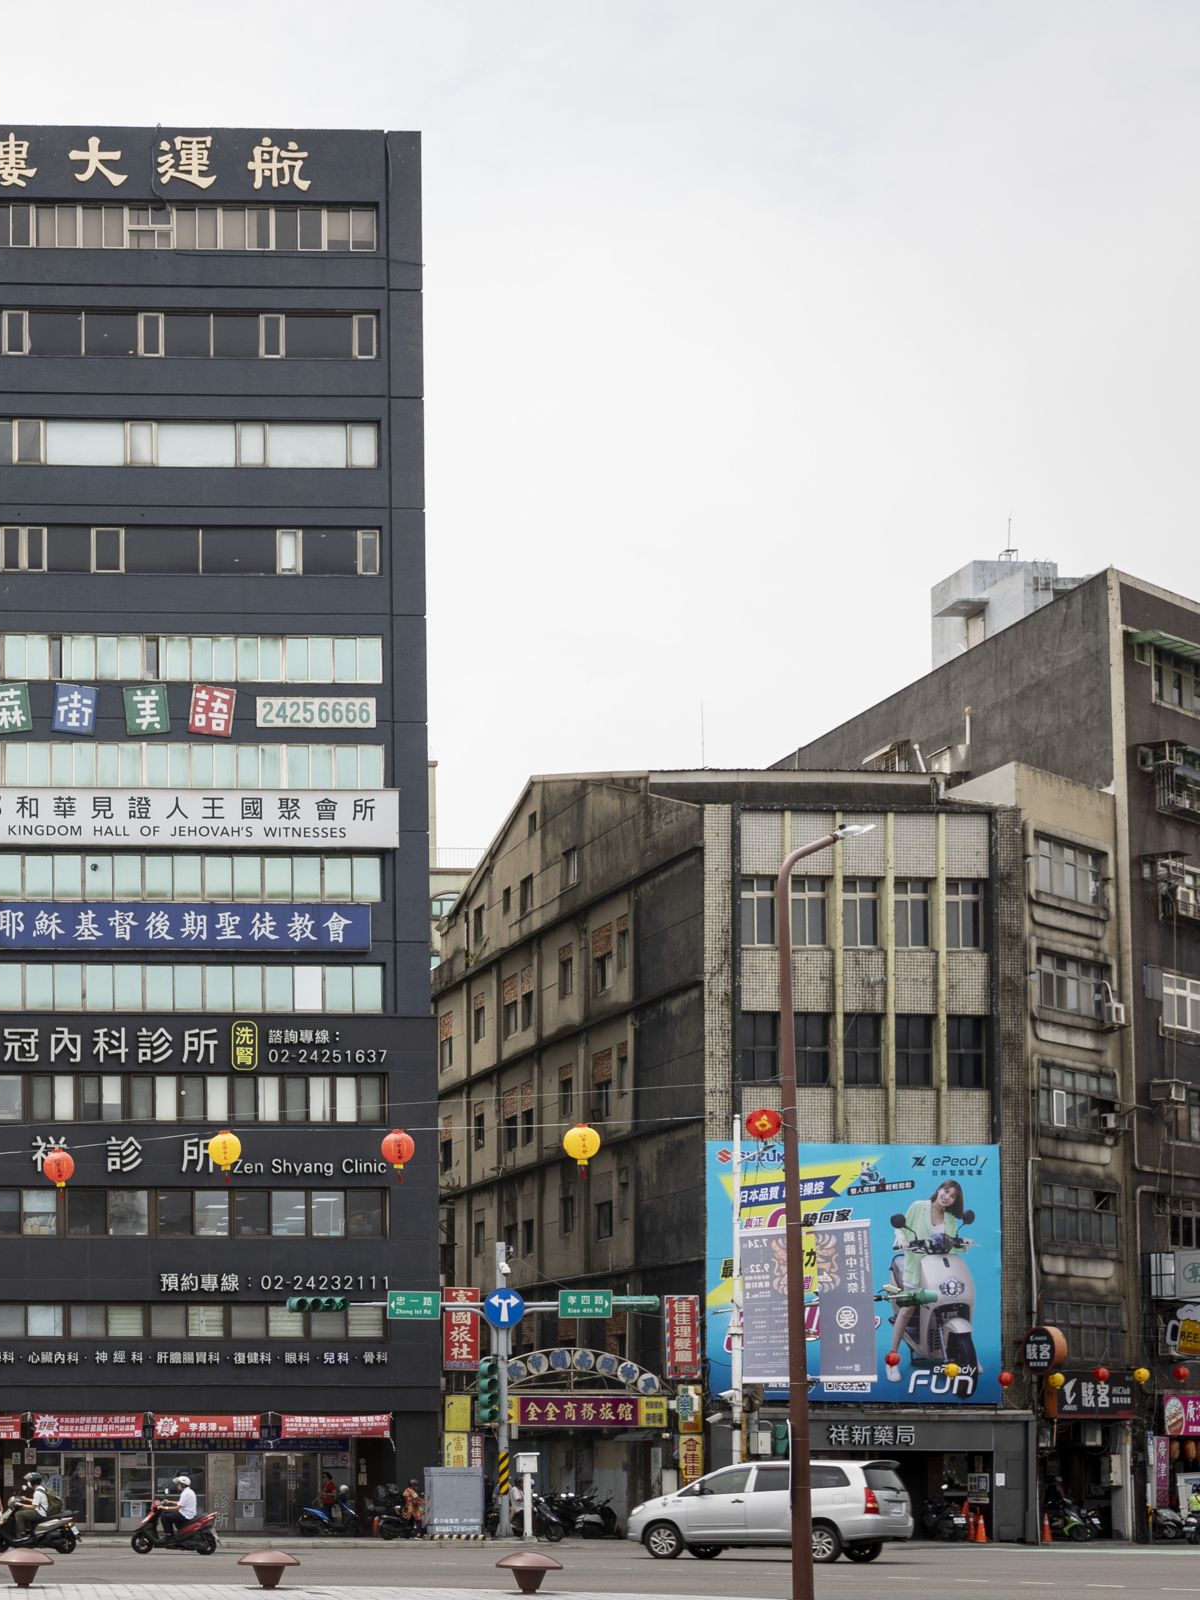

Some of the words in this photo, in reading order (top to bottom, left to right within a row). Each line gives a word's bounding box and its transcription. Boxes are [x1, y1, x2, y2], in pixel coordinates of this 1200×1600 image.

[262, 700, 371, 725] 24256666
[7, 824, 82, 838] KINGDOM
[93, 824, 130, 837] HALL
[140, 824, 161, 838] OF
[170, 824, 254, 838] JEHOVAH'S
[263, 825, 347, 839] WITNESSES
[235, 1026, 254, 1066] 洗腎
[268, 1048, 388, 1064] 02-24251637
[740, 1151, 785, 1162] SUZUK
[233, 1158, 264, 1175] Zen
[271, 1158, 334, 1178] Shyang
[342, 1158, 387, 1175] Clinic
[260, 1274, 390, 1291] 02-24232111
[396, 1296, 432, 1306] 忠一路
[568, 1295, 604, 1304] 孝四路
[449, 1290, 475, 1359] 富國旅社
[673, 1300, 692, 1362] 佳佳理髮廳
[1180, 1330, 1200, 1344] BEE
[95, 1351, 143, 1364] 神經科
[285, 1352, 310, 1364] 眼科
[323, 1352, 349, 1365] 兒科
[362, 1352, 388, 1364] 骨科
[1081, 1381, 1110, 1407] 駭客
[525, 1401, 634, 1421] 金金商務旅館
[829, 1425, 915, 1446] 祥新藥局
